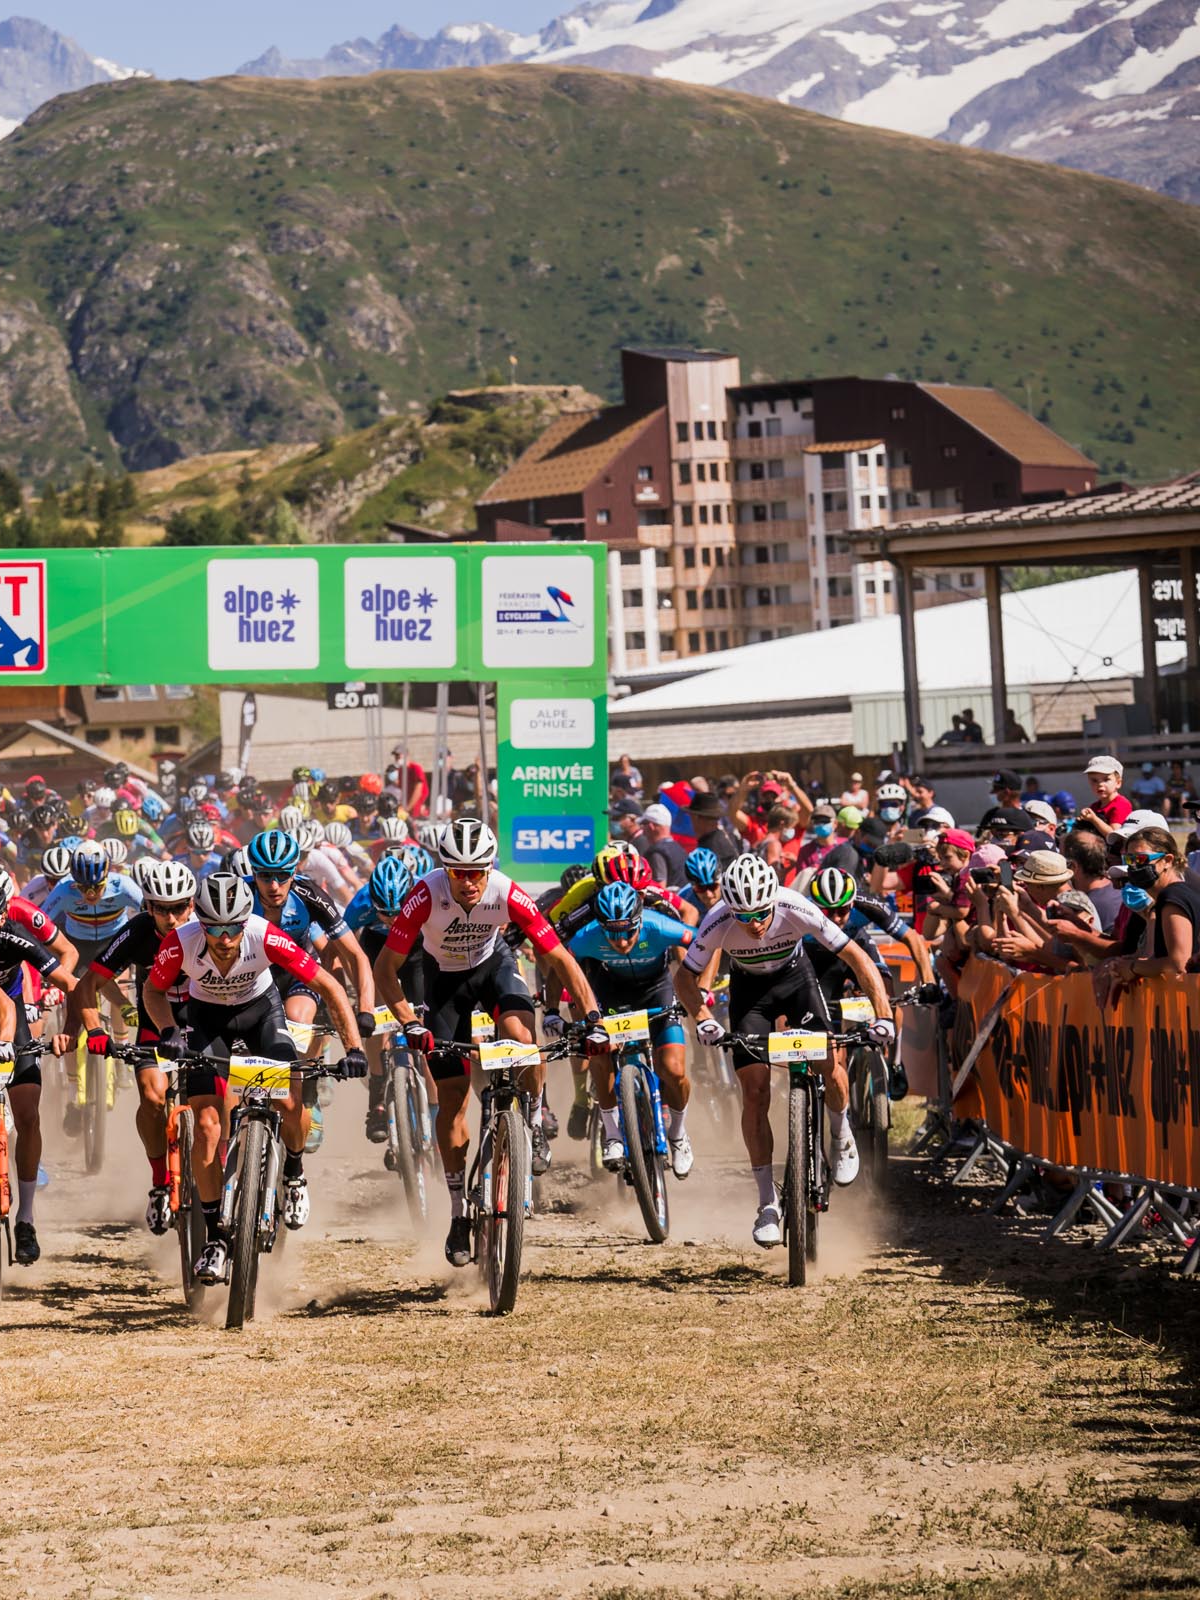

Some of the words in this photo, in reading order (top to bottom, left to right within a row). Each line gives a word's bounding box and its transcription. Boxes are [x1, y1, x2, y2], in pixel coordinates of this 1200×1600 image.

[224, 585, 274, 615] alpe
[361, 583, 410, 614] alpe
[238, 615, 295, 643] huez
[375, 614, 433, 641] huez
[335, 692, 359, 708] 50
[362, 693, 378, 707] m
[537, 709, 569, 719] ALPE
[529, 718, 576, 729] D'HUEZ
[511, 762, 594, 781] ARRIVÉE
[523, 783, 582, 798] FINISH
[515, 829, 586, 850] SKF
[401, 888, 428, 919] BMC
[510, 889, 539, 917] BMC
[778, 901, 814, 916] cannondale
[267, 934, 297, 953] BMC
[730, 940, 797, 955] cannondale
[615, 1019, 631, 1031] 12
[505, 1048, 514, 1056] 7
[792, 1040, 802, 1049] 6
[256, 1071, 264, 1085] 4
